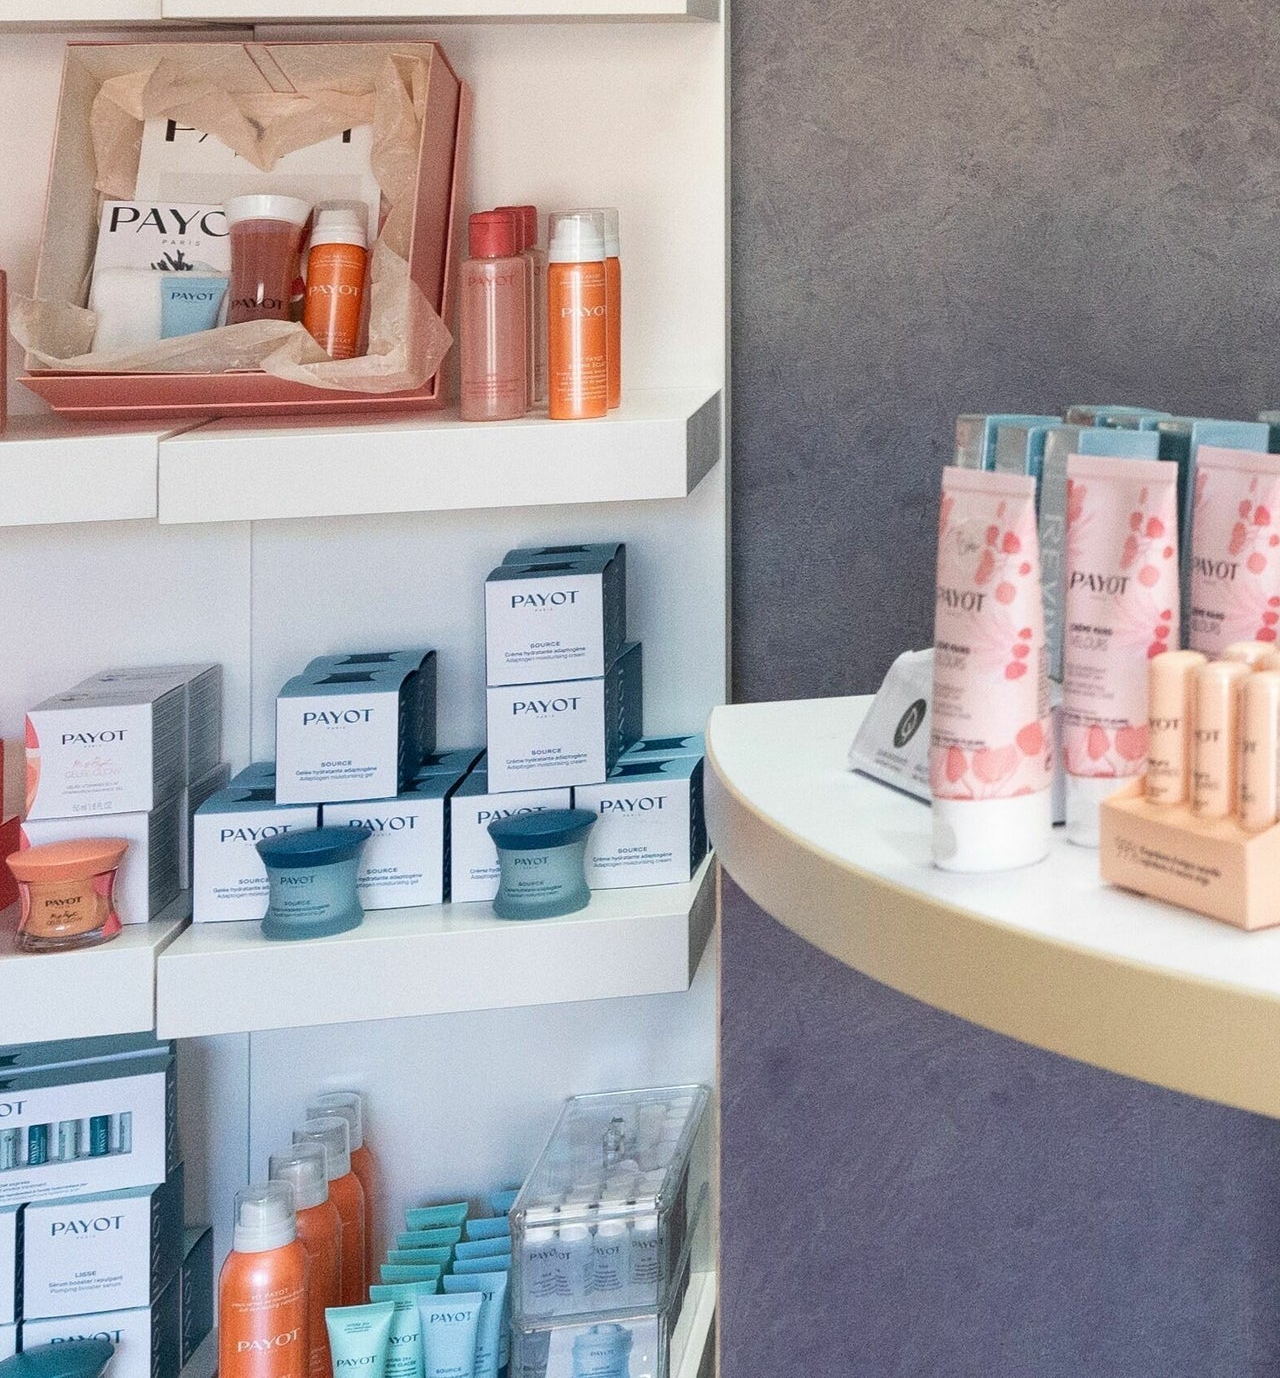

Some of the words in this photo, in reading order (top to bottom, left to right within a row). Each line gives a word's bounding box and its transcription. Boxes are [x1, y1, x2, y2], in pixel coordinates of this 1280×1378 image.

[162, 239, 201, 247] PARIS
[467, 275, 513, 287] PAYOT
[171, 292, 216, 302] PAYOT
[308, 284, 360, 297] PAYOT
[231, 298, 283, 311] PAYOT
[1194, 556, 1239, 581] PAYOT
[1070, 572, 1130, 596] PAYOT
[512, 590, 580, 609] PAYOT
[938, 587, 986, 613] PAYOT
[513, 697, 581, 716] PAYOT
[303, 709, 374, 726] PAYOT
[61, 730, 128, 745] PAYOT
[531, 748, 562, 756] SOURCE
[600, 796, 668, 814] PAYOT
[515, 856, 549, 866] PAYOT
[280, 876, 316, 885] PAYOT
[45, 895, 82, 907] PAYOT
[51, 1215, 125, 1237] PAYOT
[74, 1270, 97, 1279] LISSE
[430, 1311, 472, 1323] PAYOT
[237, 1327, 301, 1353] PAYOT
[336, 1356, 377, 1368] PAYOT
